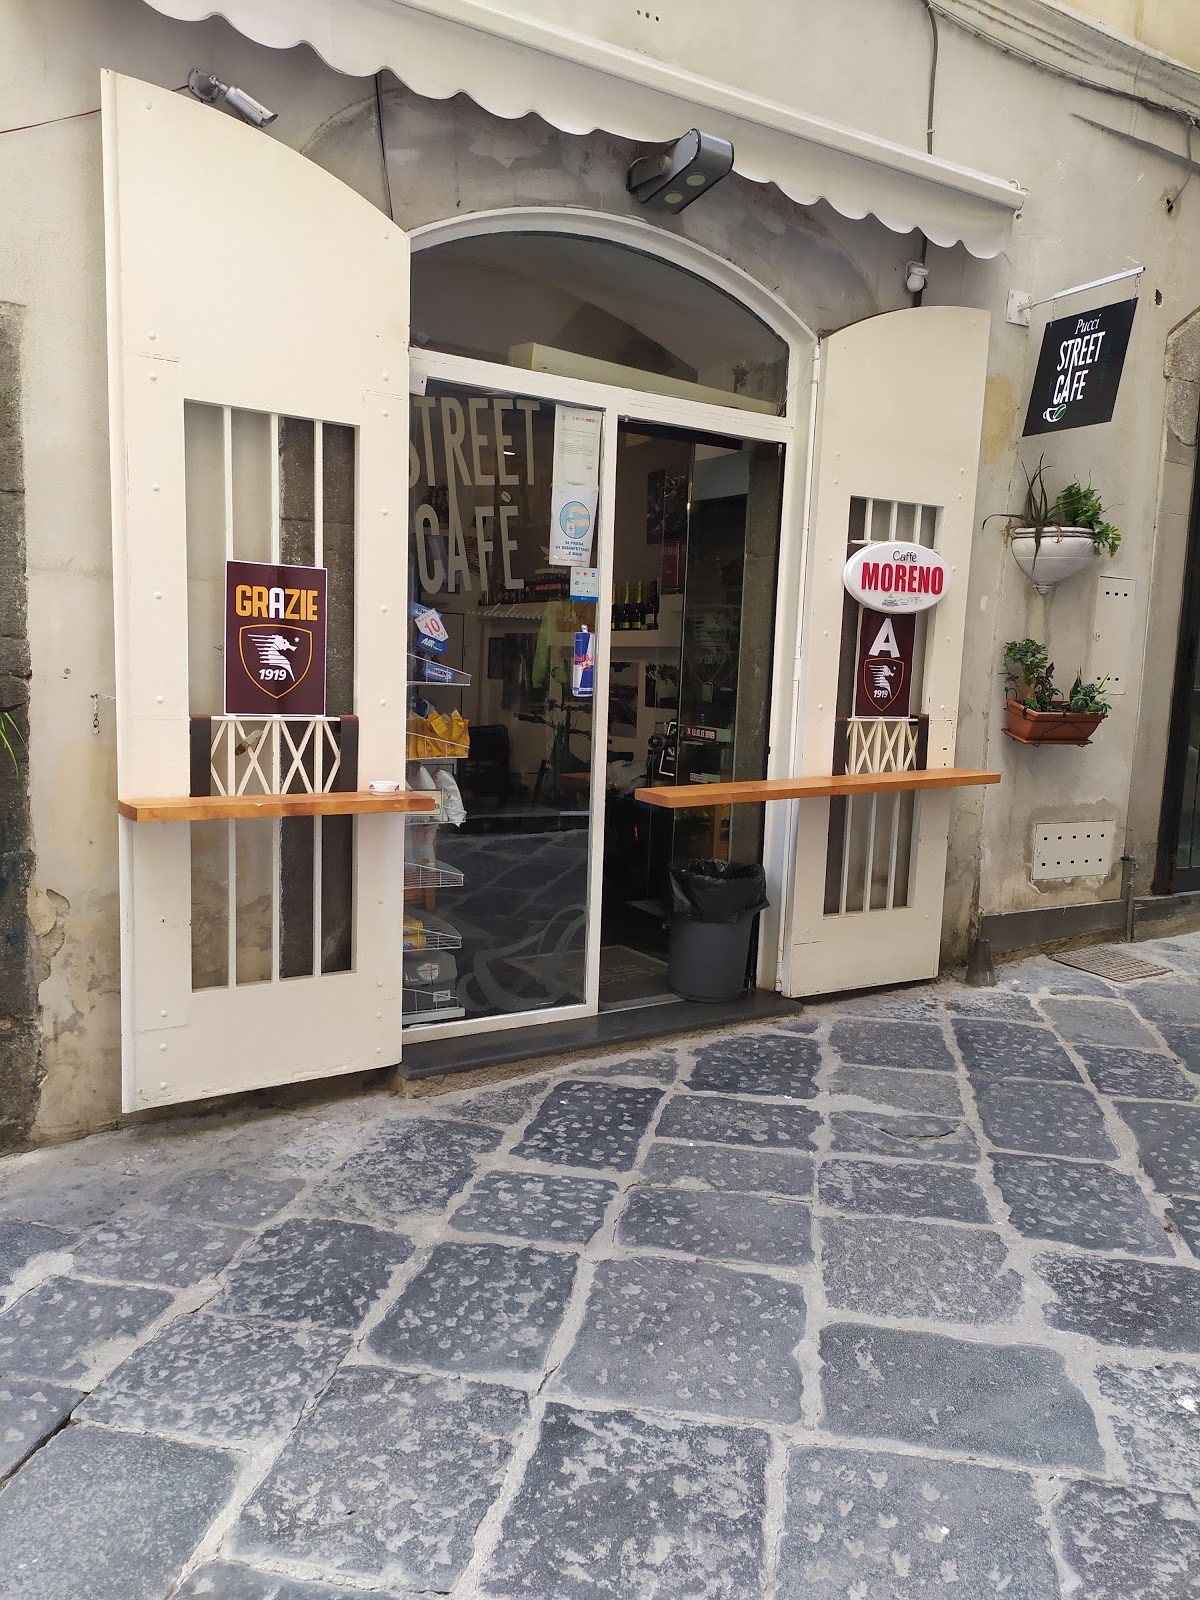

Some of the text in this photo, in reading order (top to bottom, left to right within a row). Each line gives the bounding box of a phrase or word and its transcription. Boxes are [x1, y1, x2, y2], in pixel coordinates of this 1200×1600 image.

[1074, 313, 1102, 335] Pucci
[1056, 331, 1106, 372] STREET
[860, 561, 944, 595] MORENO
[235, 584, 319, 621] GRAZIE
[424, 617, 441, 636] 10
[868, 617, 901, 658] A
[258, 668, 287, 680] 1919
[873, 689, 888, 698] 1919
